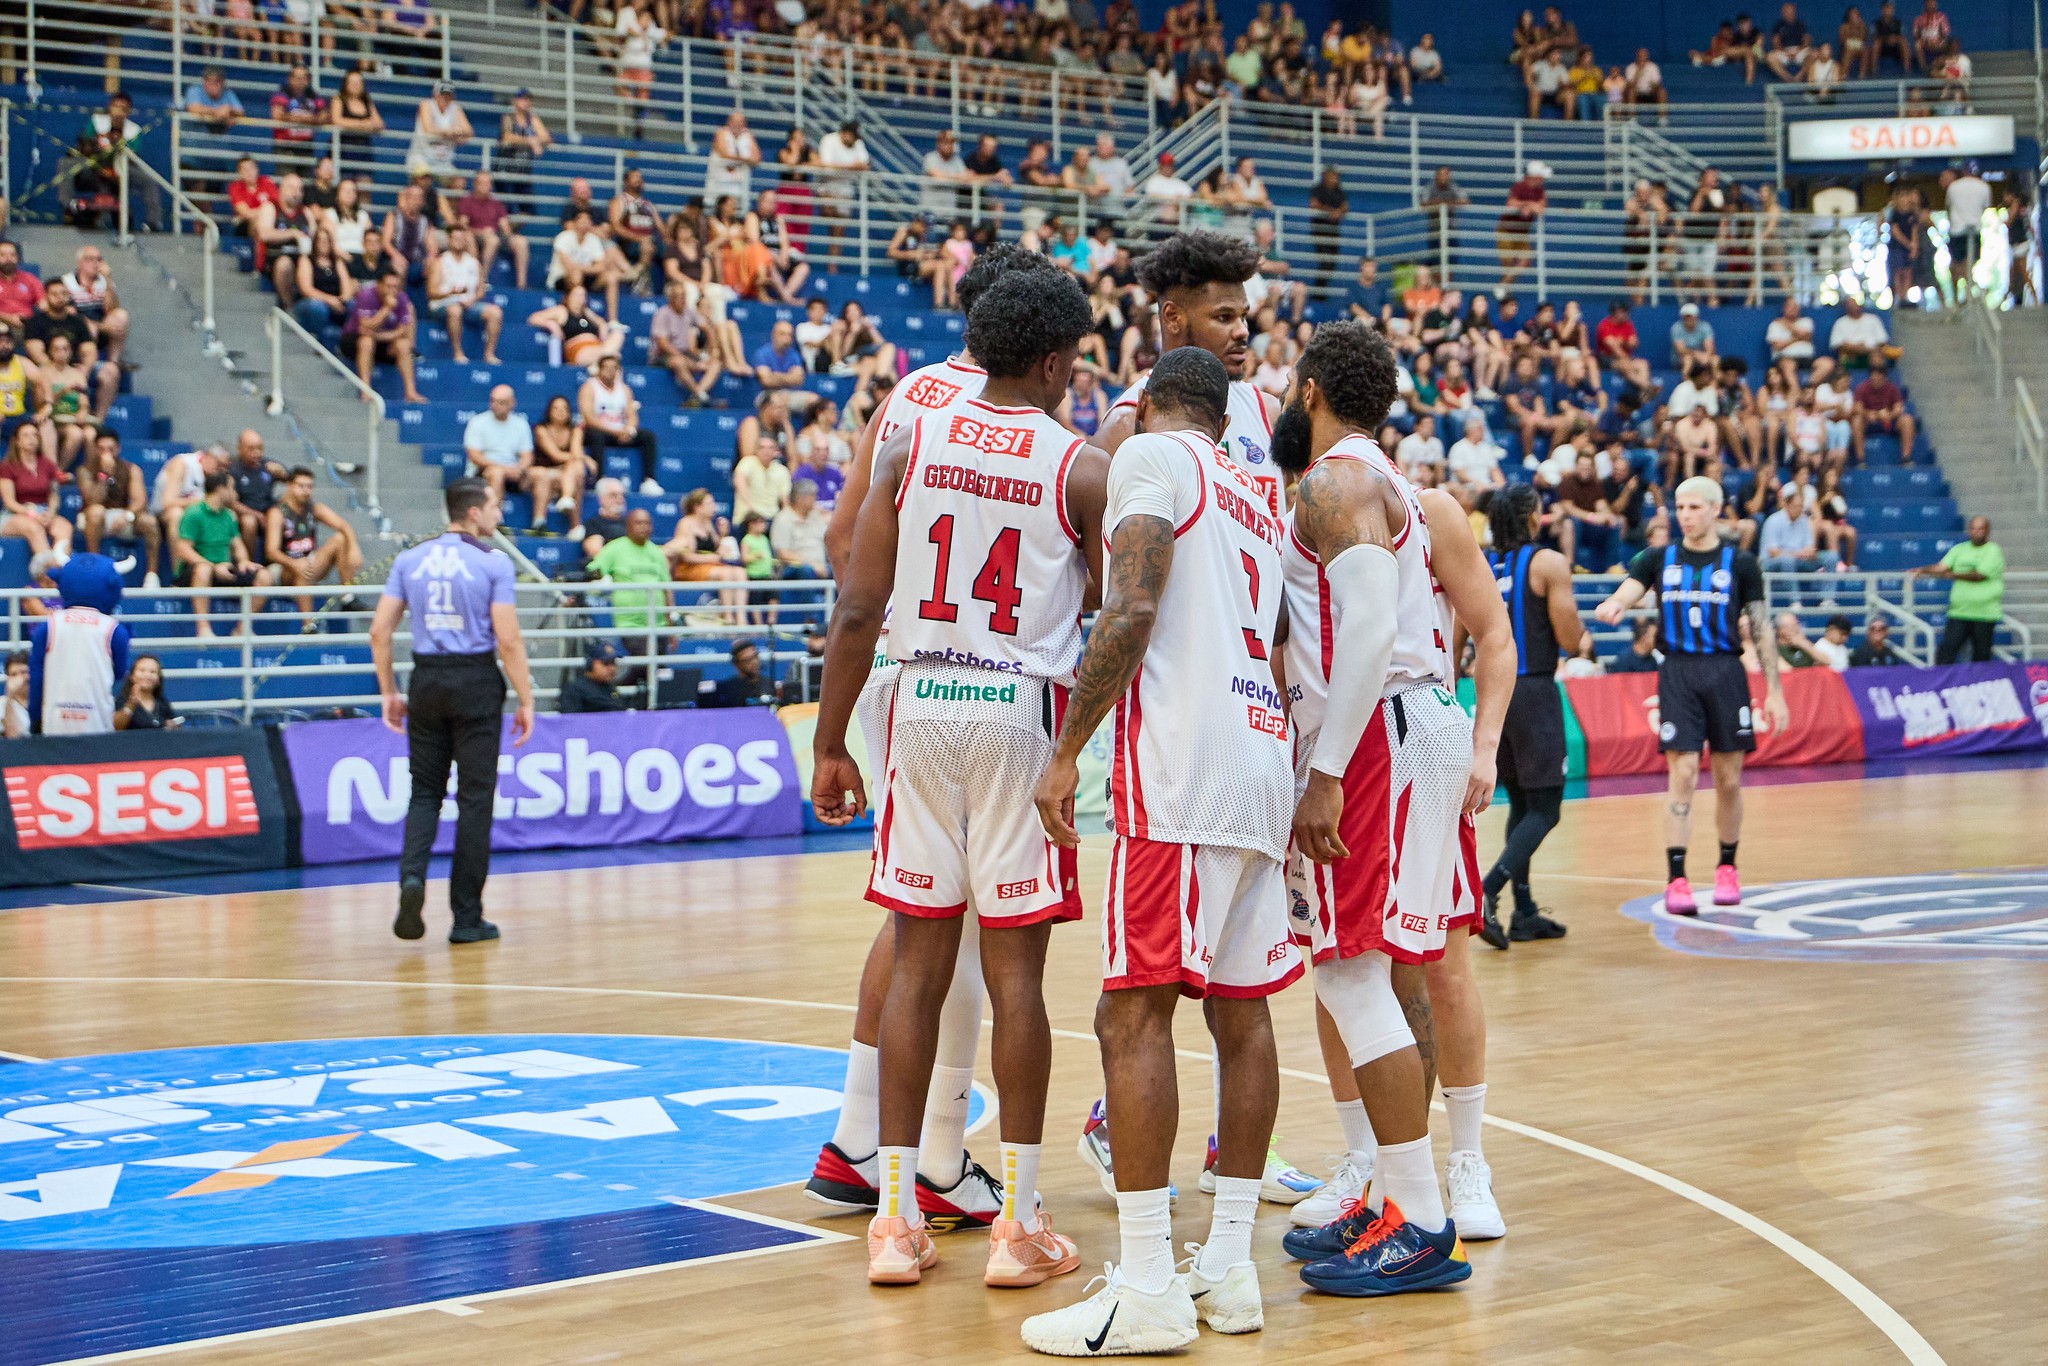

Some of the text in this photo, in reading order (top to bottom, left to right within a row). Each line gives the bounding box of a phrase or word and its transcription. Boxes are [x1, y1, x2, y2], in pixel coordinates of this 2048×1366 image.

[956, 421, 1026, 454] SESI
[919, 514, 1022, 636] 14
[427, 581, 456, 612] 21
[915, 679, 1016, 703] Unimed
[327, 738, 783, 824] Ntshoes
[37, 767, 227, 838] SESI
[896, 870, 930, 887] FIESP
[1001, 881, 1034, 897] SESI
[292, 1055, 407, 1071] LADO
[198, 1089, 524, 1132] GOVERNO
